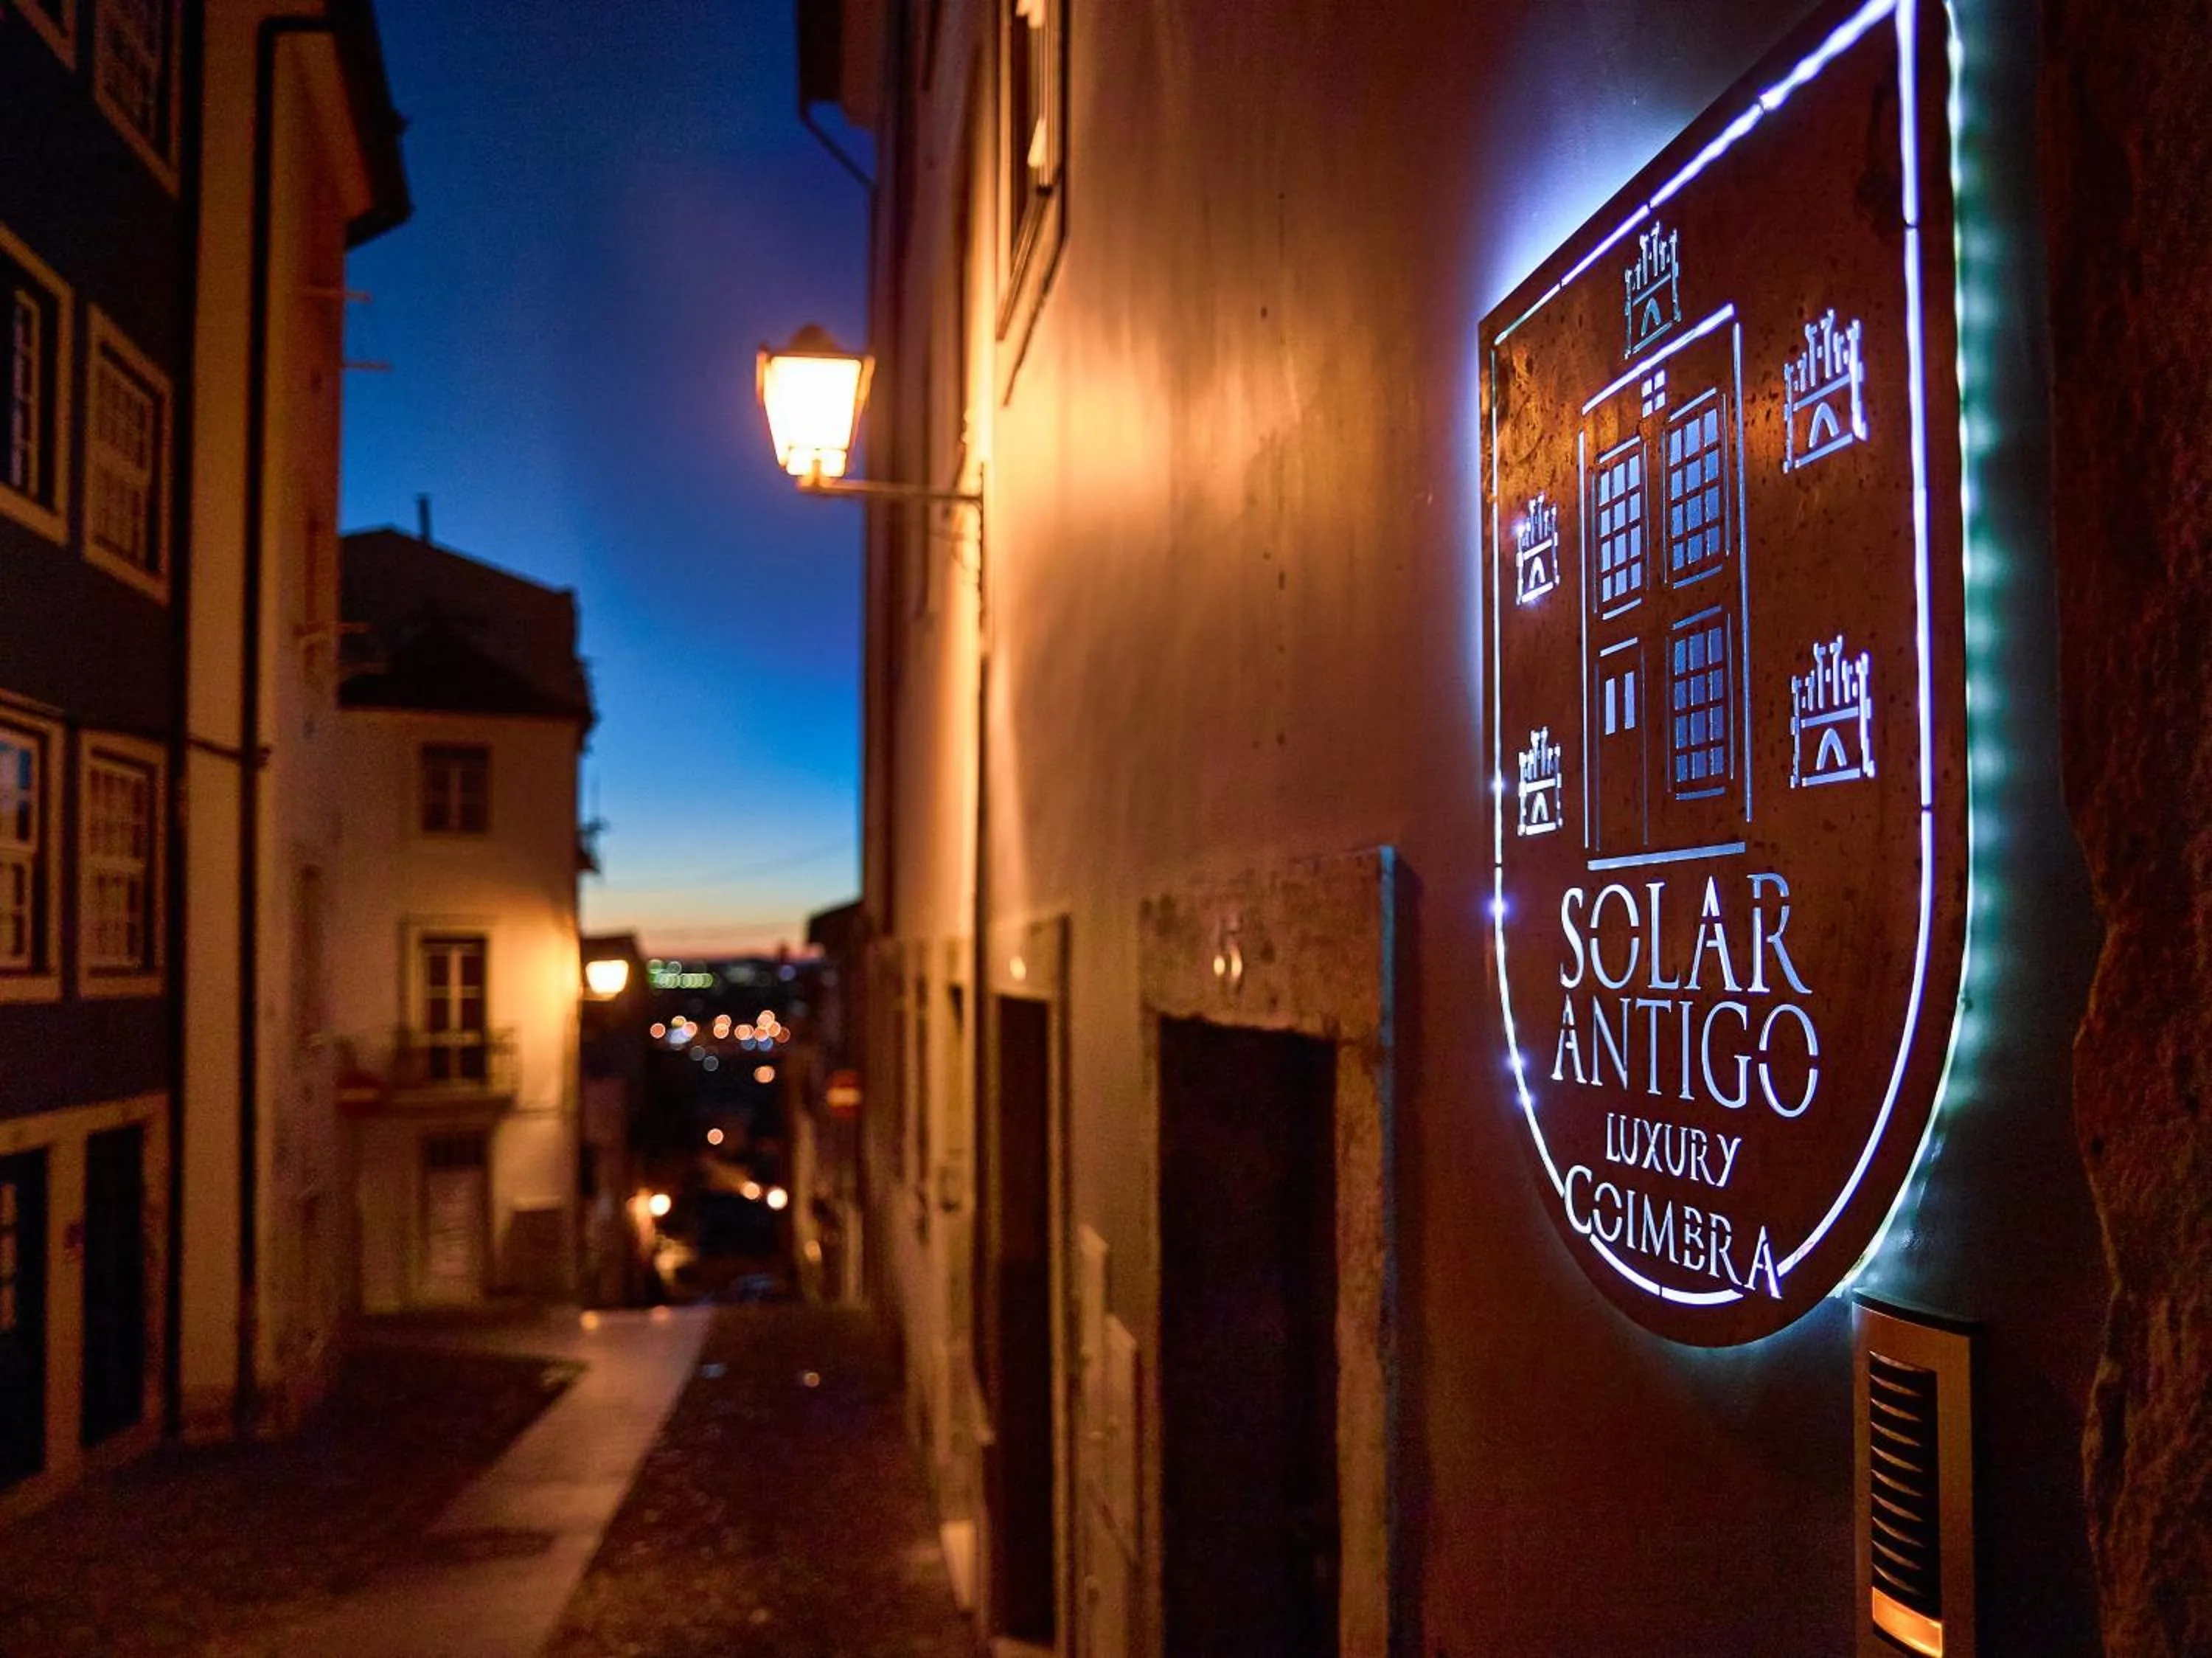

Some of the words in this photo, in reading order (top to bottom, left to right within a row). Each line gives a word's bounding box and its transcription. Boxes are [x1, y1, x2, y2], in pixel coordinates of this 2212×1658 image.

[1560, 873, 1812, 993] SOLAR
[1551, 995, 1818, 1117] ANTIGO
[1606, 1113, 1741, 1186] LUXURY
[1564, 1165, 1781, 1298] COIMBRA
